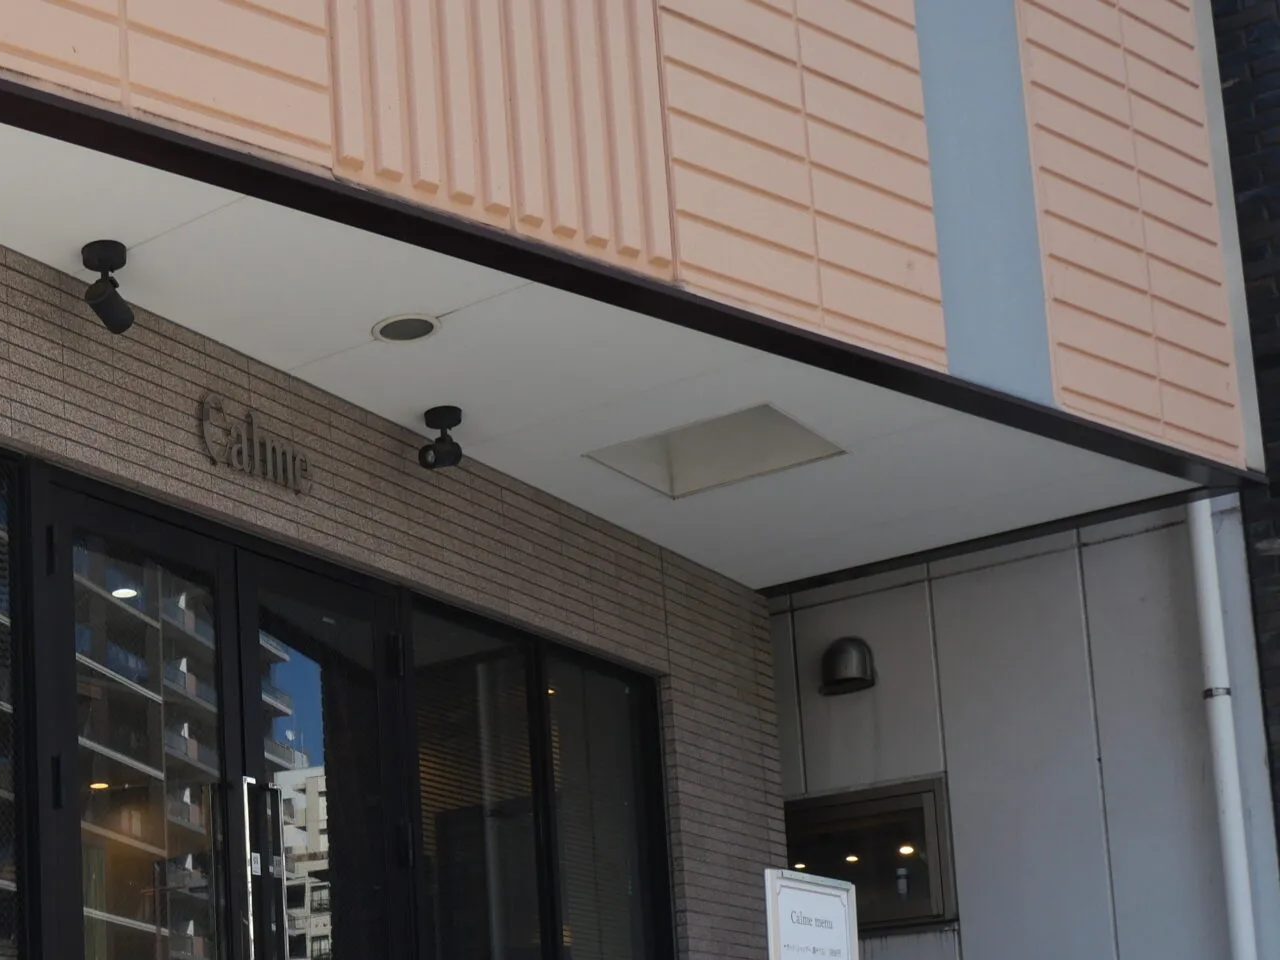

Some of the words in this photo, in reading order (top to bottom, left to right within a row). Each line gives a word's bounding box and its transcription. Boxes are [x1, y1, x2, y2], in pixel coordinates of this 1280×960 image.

[202, 393, 312, 494] Calme
[790, 910, 813, 926] Calme
[814, 917, 833, 929] menu
